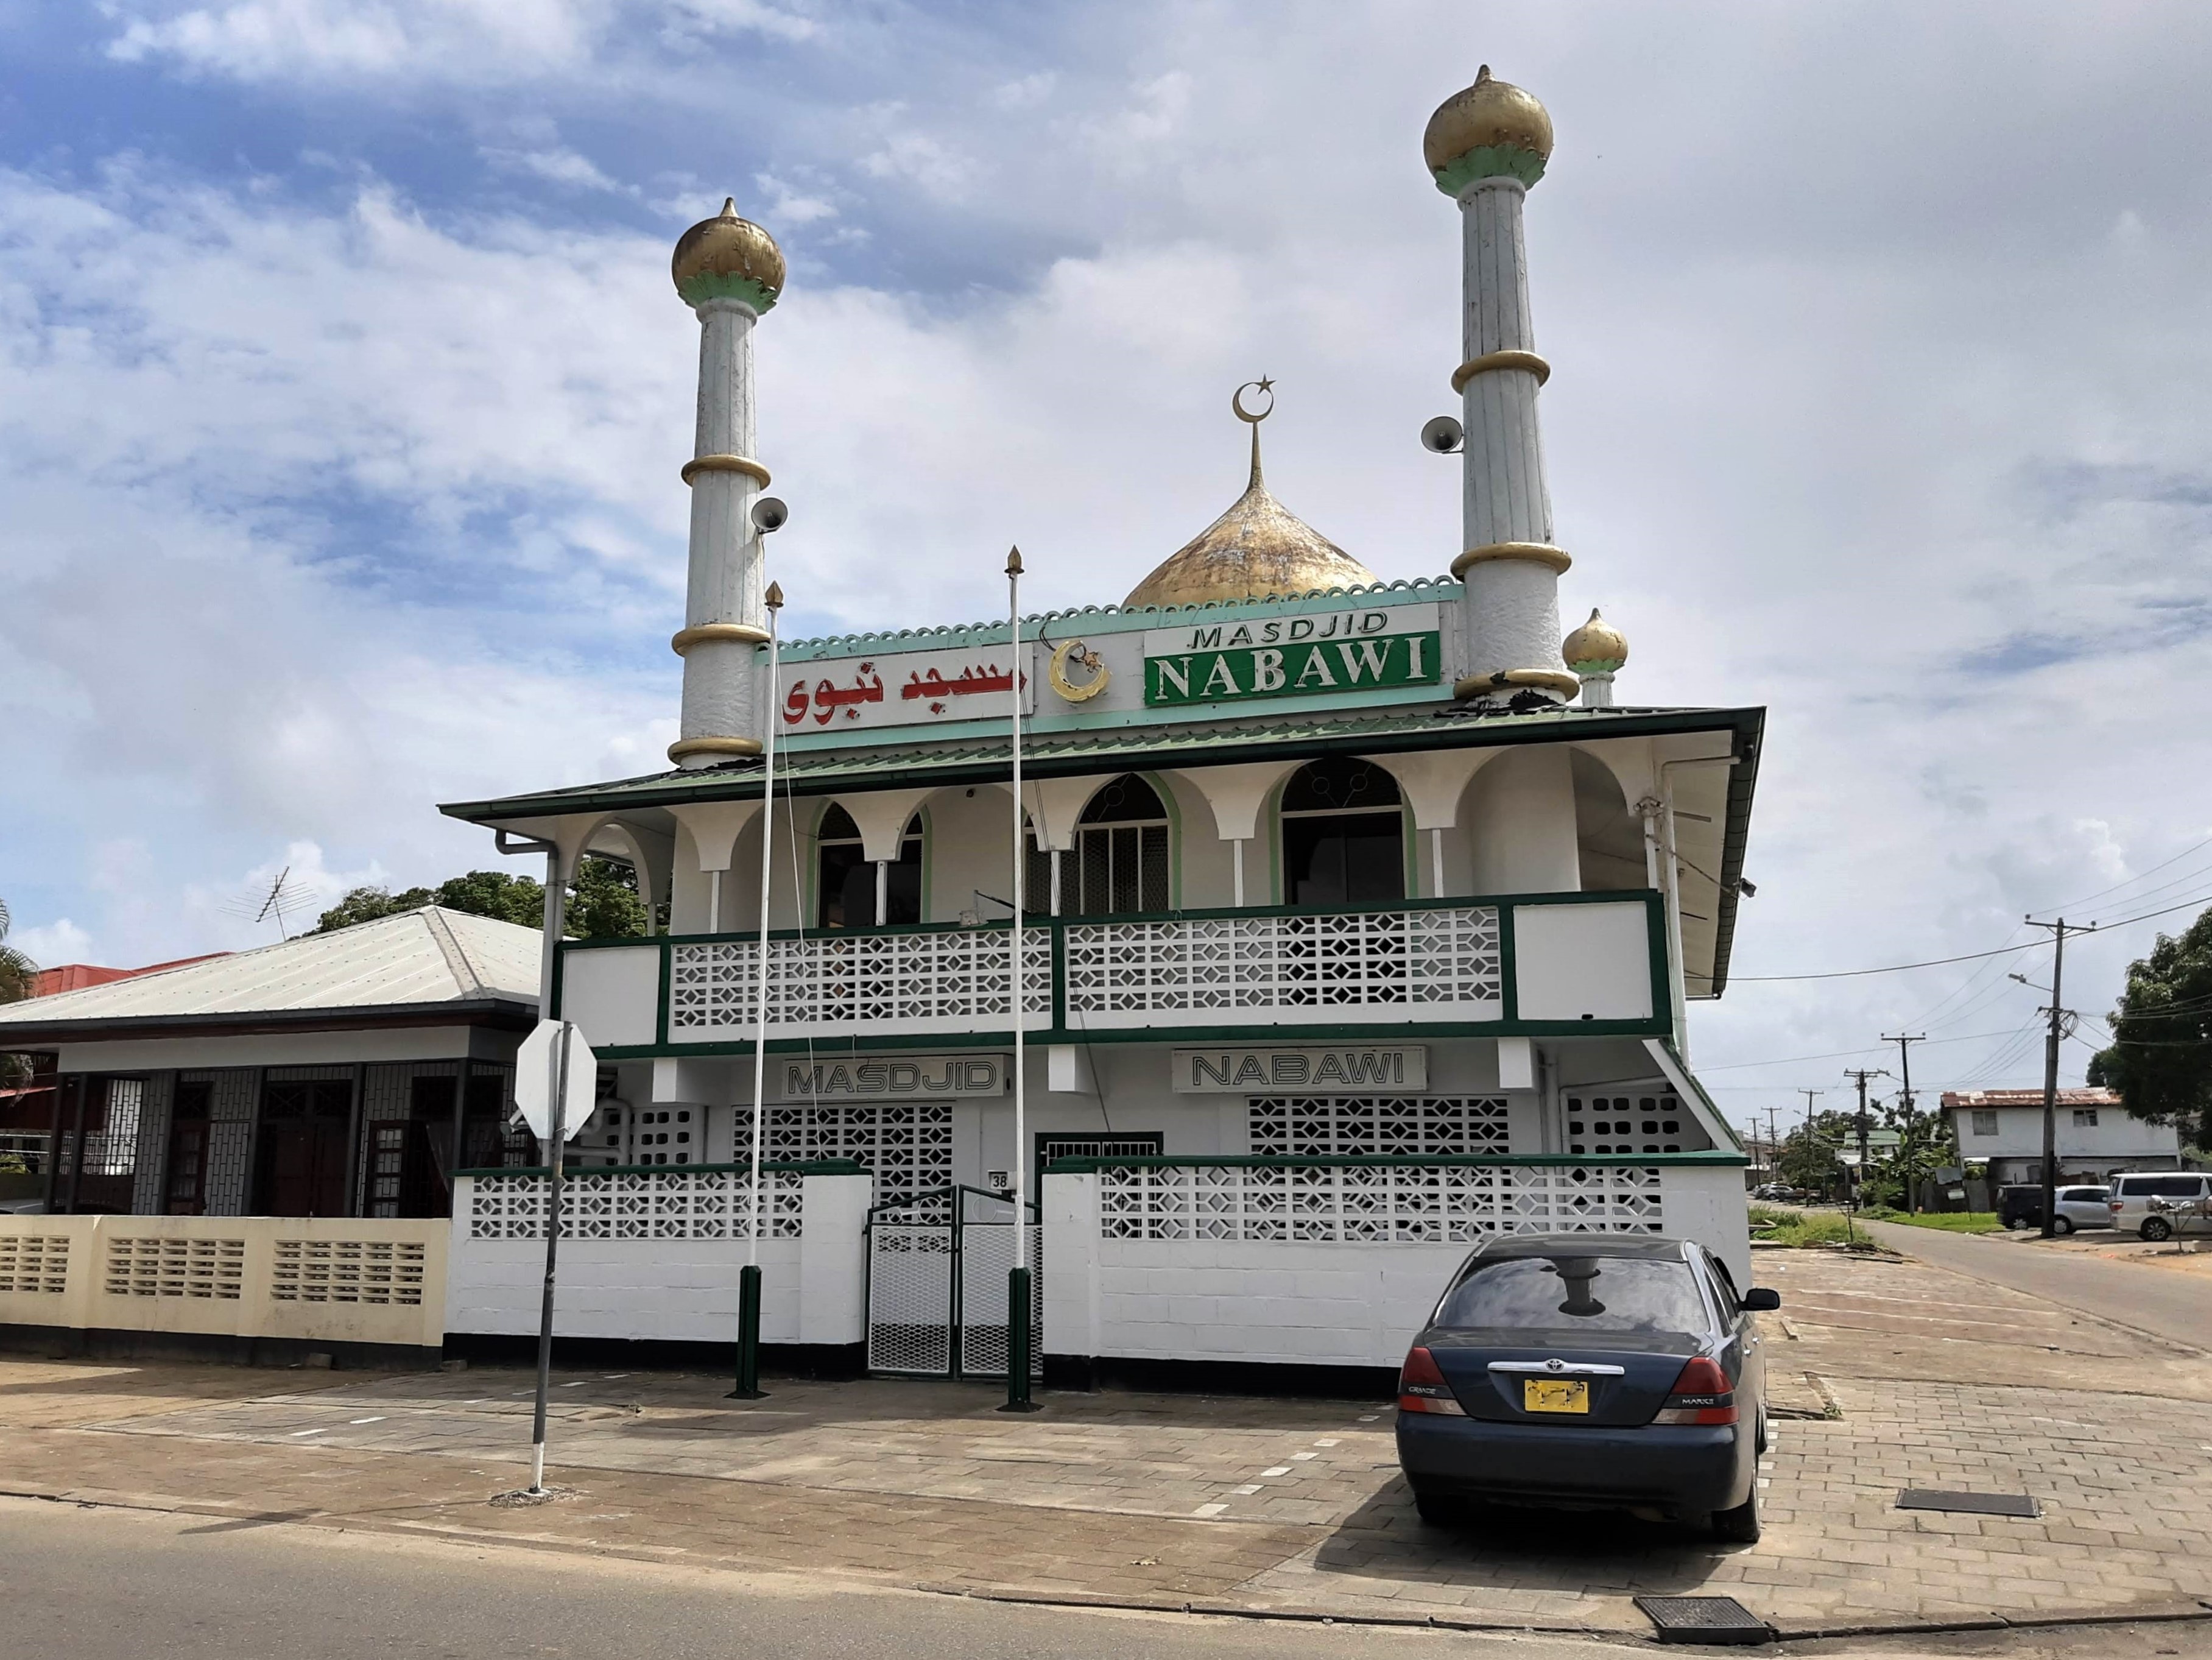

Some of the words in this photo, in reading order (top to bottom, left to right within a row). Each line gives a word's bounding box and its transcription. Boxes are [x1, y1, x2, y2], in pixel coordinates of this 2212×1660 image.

[1191, 611, 1388, 649] MASDJID
[1154, 636, 1427, 701] NABAWI
[788, 1061, 997, 1094] MASDJID
[1192, 1053, 1404, 1086] NABAWI
[993, 1175, 1007, 1187] 38
